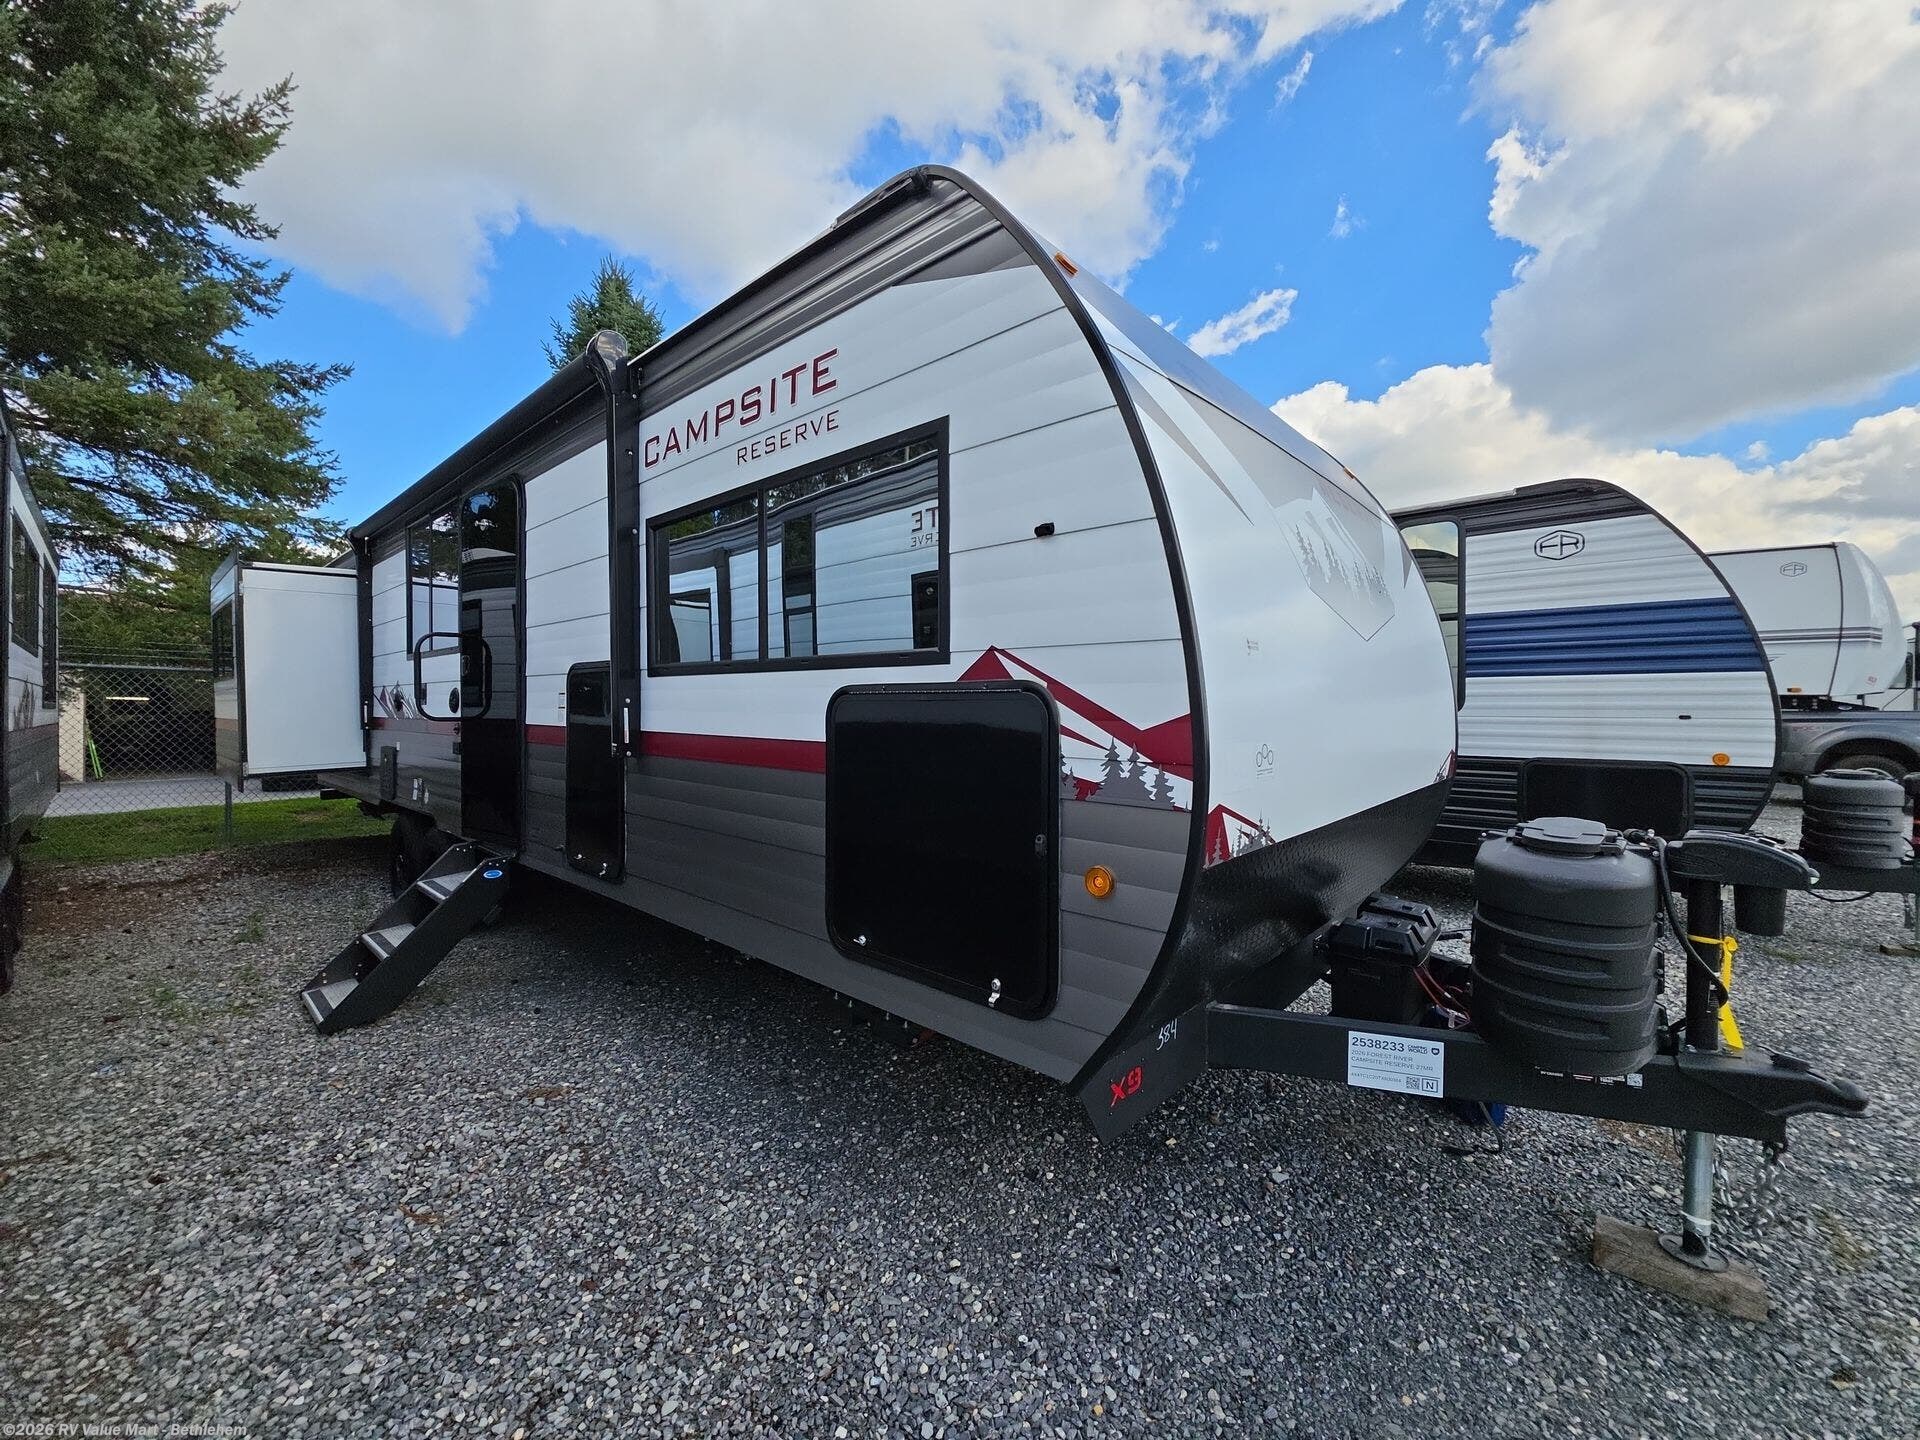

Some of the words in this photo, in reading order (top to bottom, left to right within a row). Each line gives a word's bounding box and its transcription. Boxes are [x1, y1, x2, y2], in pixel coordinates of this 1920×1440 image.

[644, 347, 839, 469] CAMPSITE
[736, 409, 840, 466] RESERVE
[1156, 1018, 1178, 1051] 584
[1352, 1037, 1405, 1052] 2538233
[1408, 1047, 1428, 1055] WORLD
[1367, 1051, 1392, 1059] FOREST
[1351, 1056, 1383, 1065] CAMPSITE
[1385, 1060, 1415, 1069] RESERVE
[1426, 1081, 1434, 1090] N
